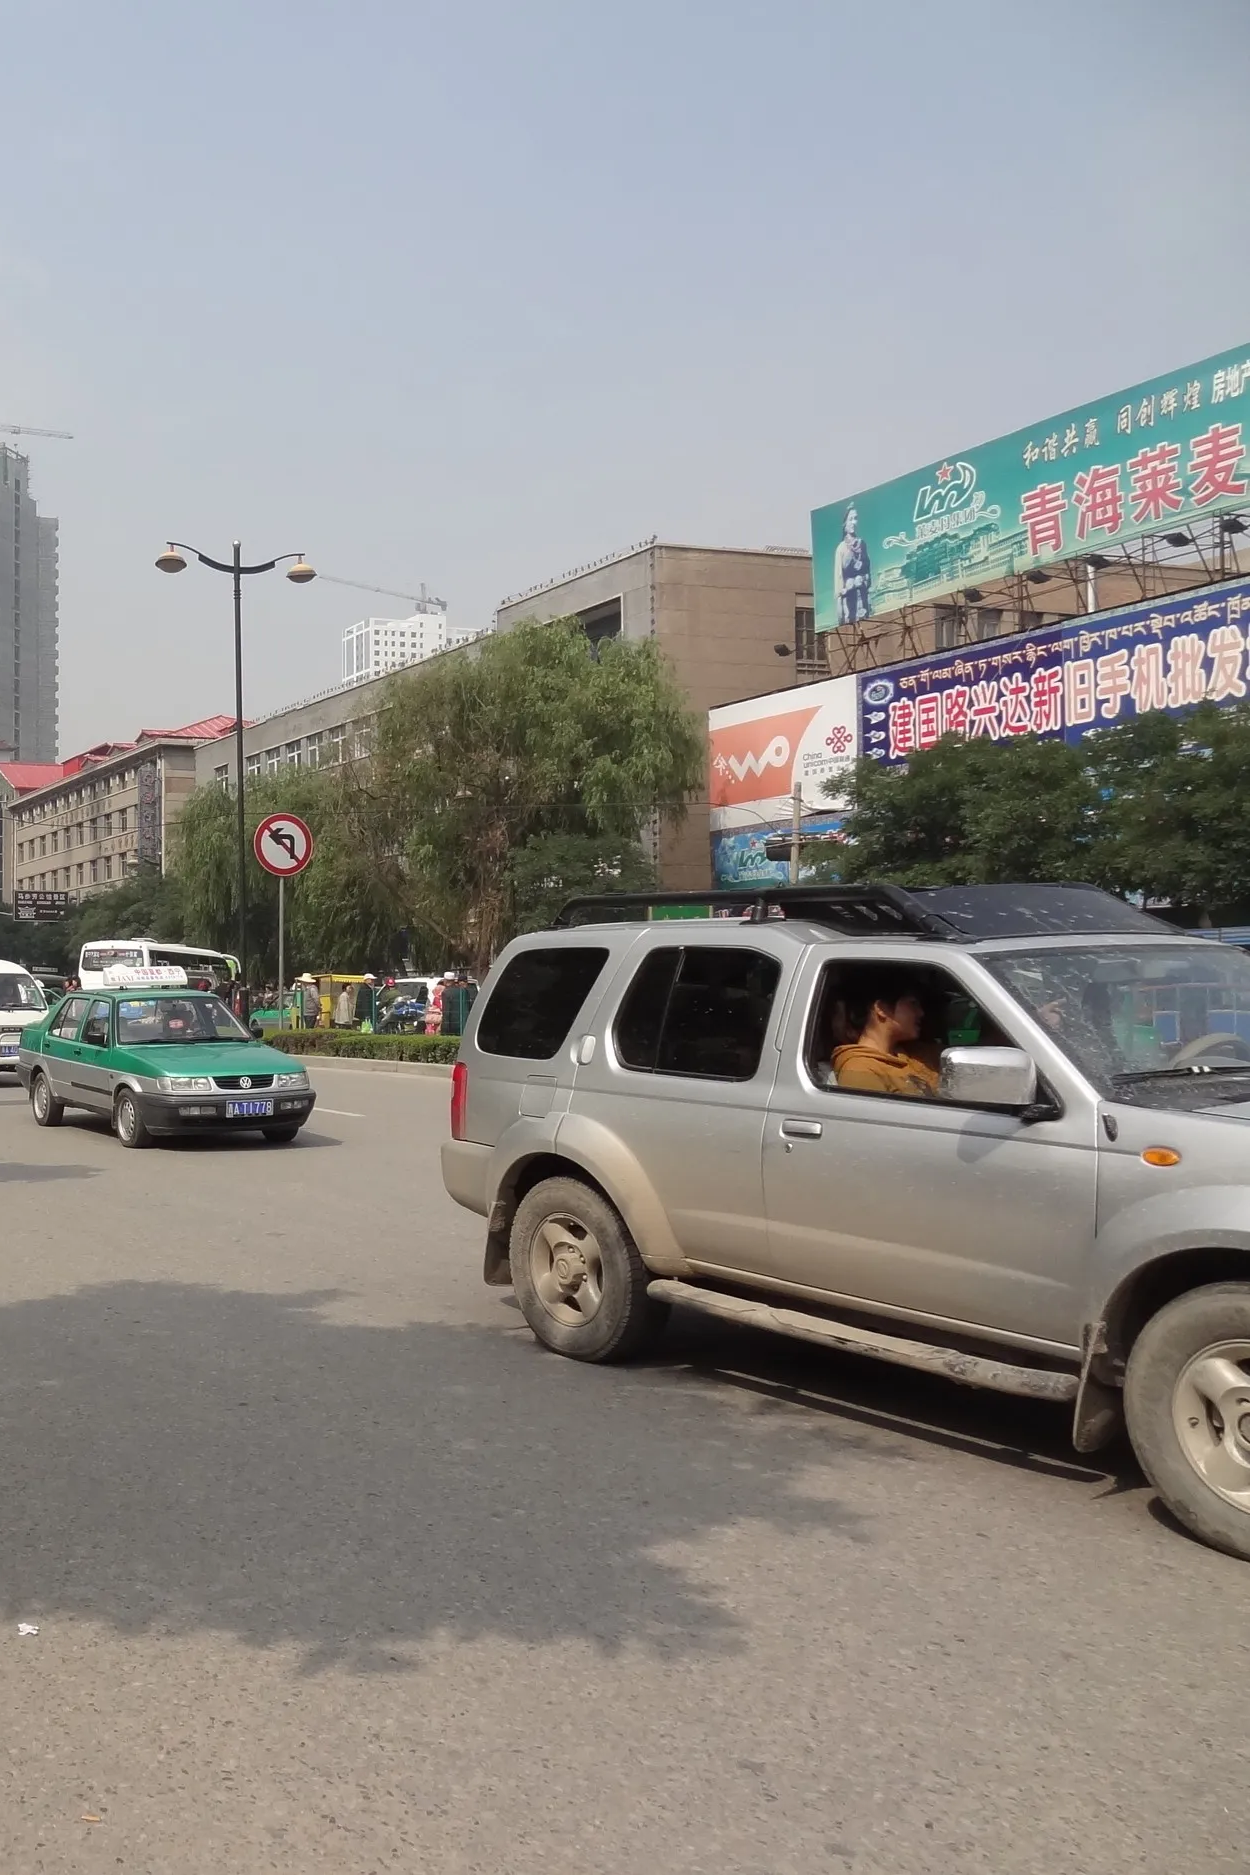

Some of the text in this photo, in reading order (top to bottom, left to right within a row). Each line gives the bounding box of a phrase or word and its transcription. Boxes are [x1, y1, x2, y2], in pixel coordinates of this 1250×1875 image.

[1022, 418, 1100, 470] 和谐共赢
[1116, 379, 1201, 435] 同创辉煌
[1019, 422, 1249, 557] 青海莱麦
[888, 623, 1250, 759] 建国路兴达新旧手机批发
[802, 752, 822, 761] China
